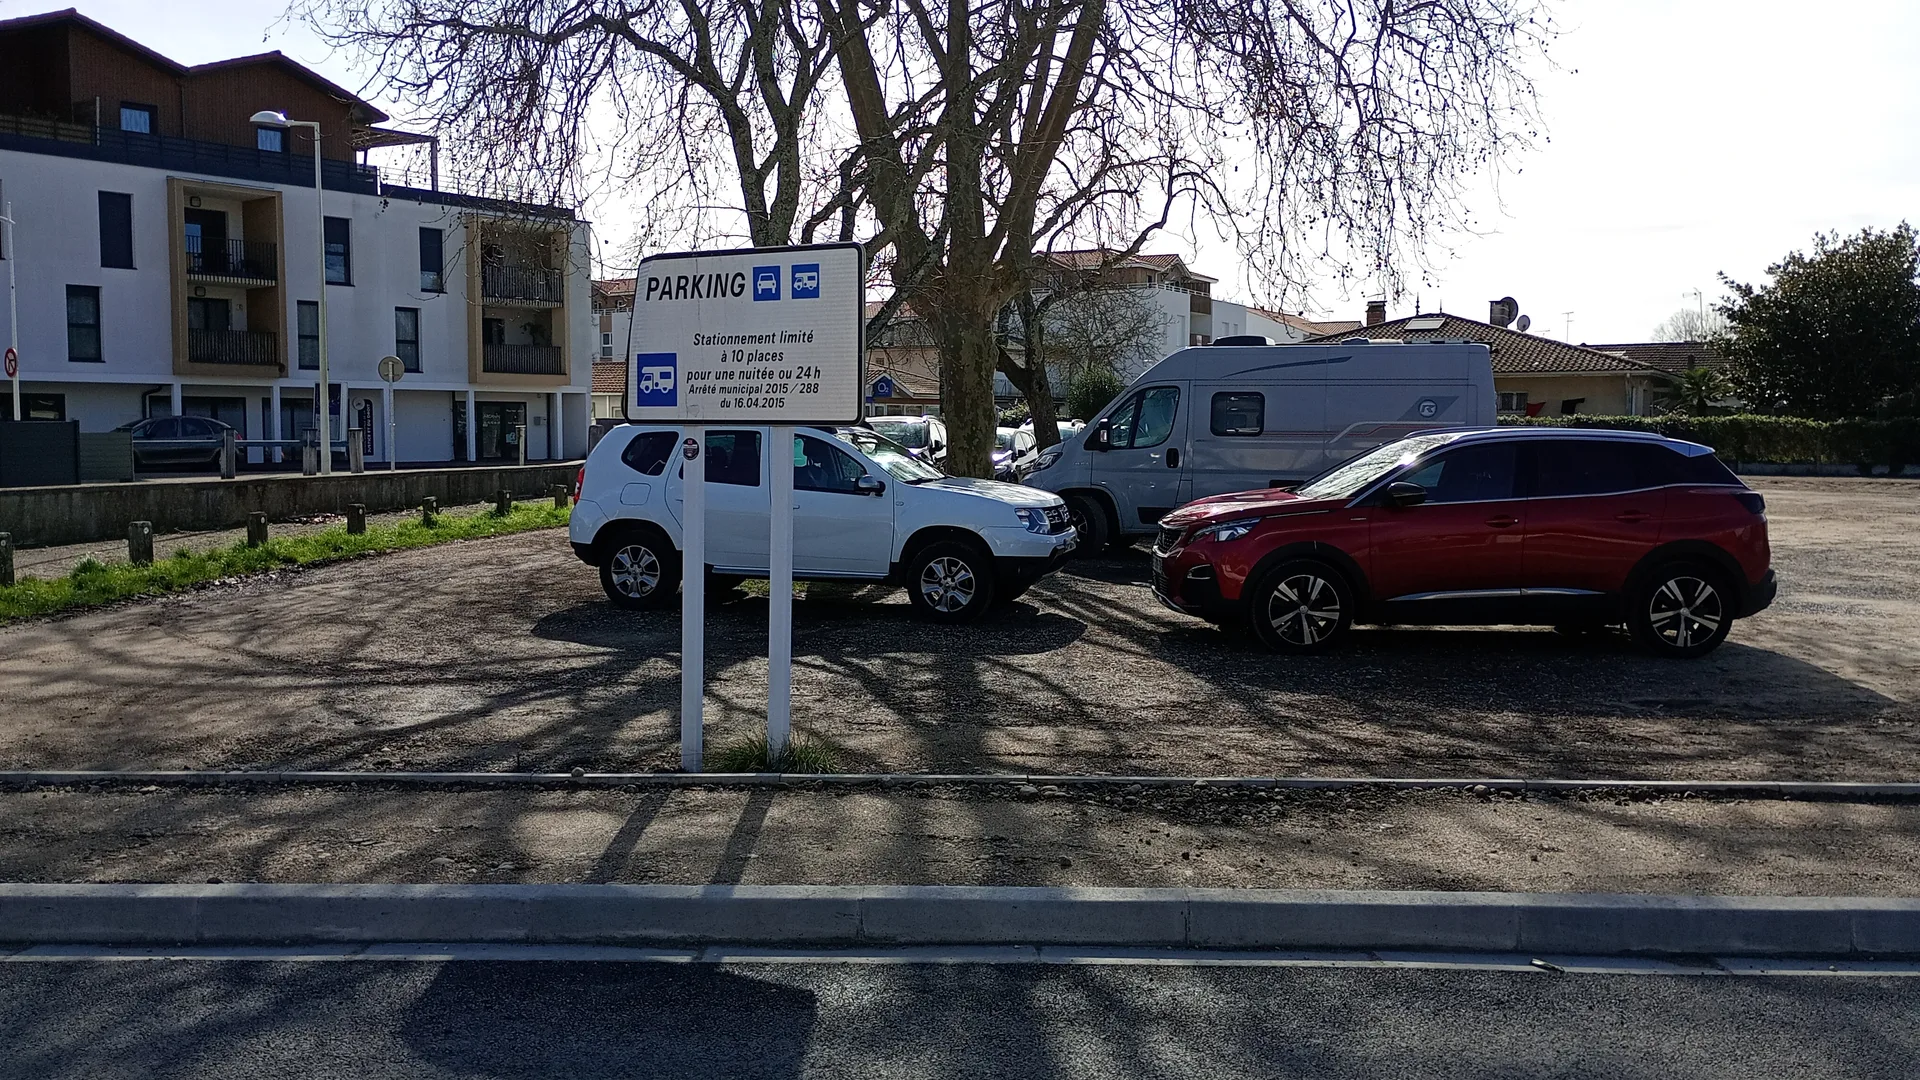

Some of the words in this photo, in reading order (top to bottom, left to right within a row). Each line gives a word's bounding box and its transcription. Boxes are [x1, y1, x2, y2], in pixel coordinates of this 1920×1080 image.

[645, 271, 746, 302] PARKING
[693, 332, 776, 346] Stationnement
[779, 329, 814, 344] limité
[720, 349, 728, 363] à
[731, 349, 744, 363] 10
[746, 349, 784, 366] places
[686, 370, 712, 384] pour
[715, 370, 735, 381] une
[738, 366, 775, 380] nuitée
[778, 369, 793, 380] ou
[795, 365, 812, 380] 24
[688, 383, 717, 395] Arrêté
[718, 383, 763, 397] municipal
[720, 397, 731, 409] du
[734, 397, 786, 409] 16.04.2015
